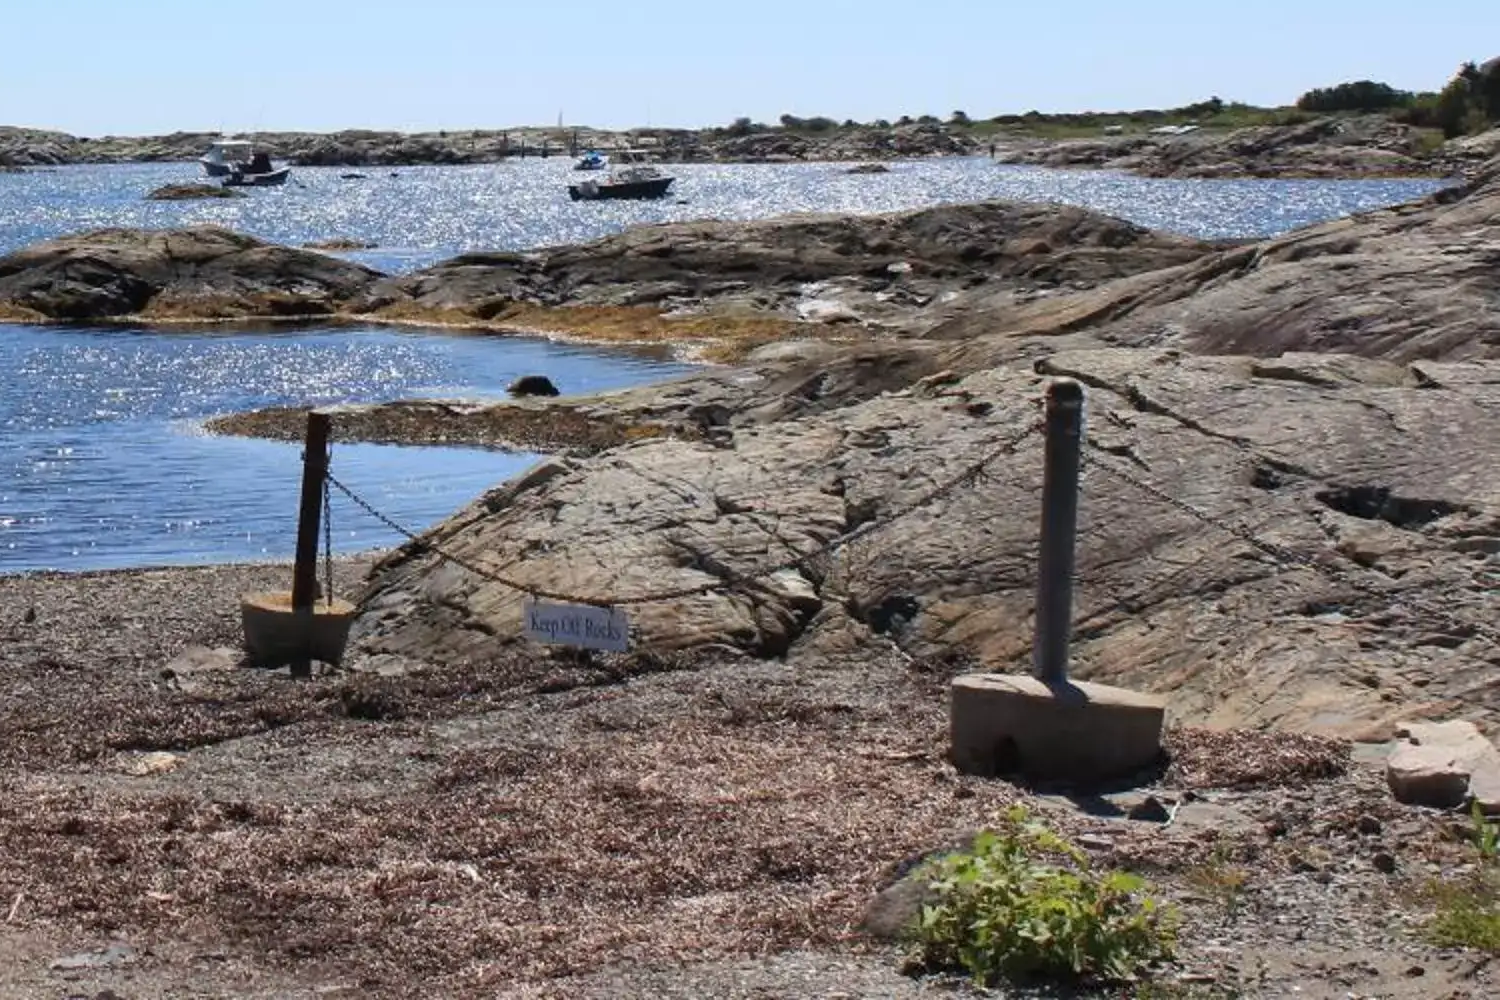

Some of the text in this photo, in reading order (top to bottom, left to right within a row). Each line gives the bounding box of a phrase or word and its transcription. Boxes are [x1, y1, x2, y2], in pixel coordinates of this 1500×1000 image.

[531, 611, 622, 642] Keep Off Rocks
